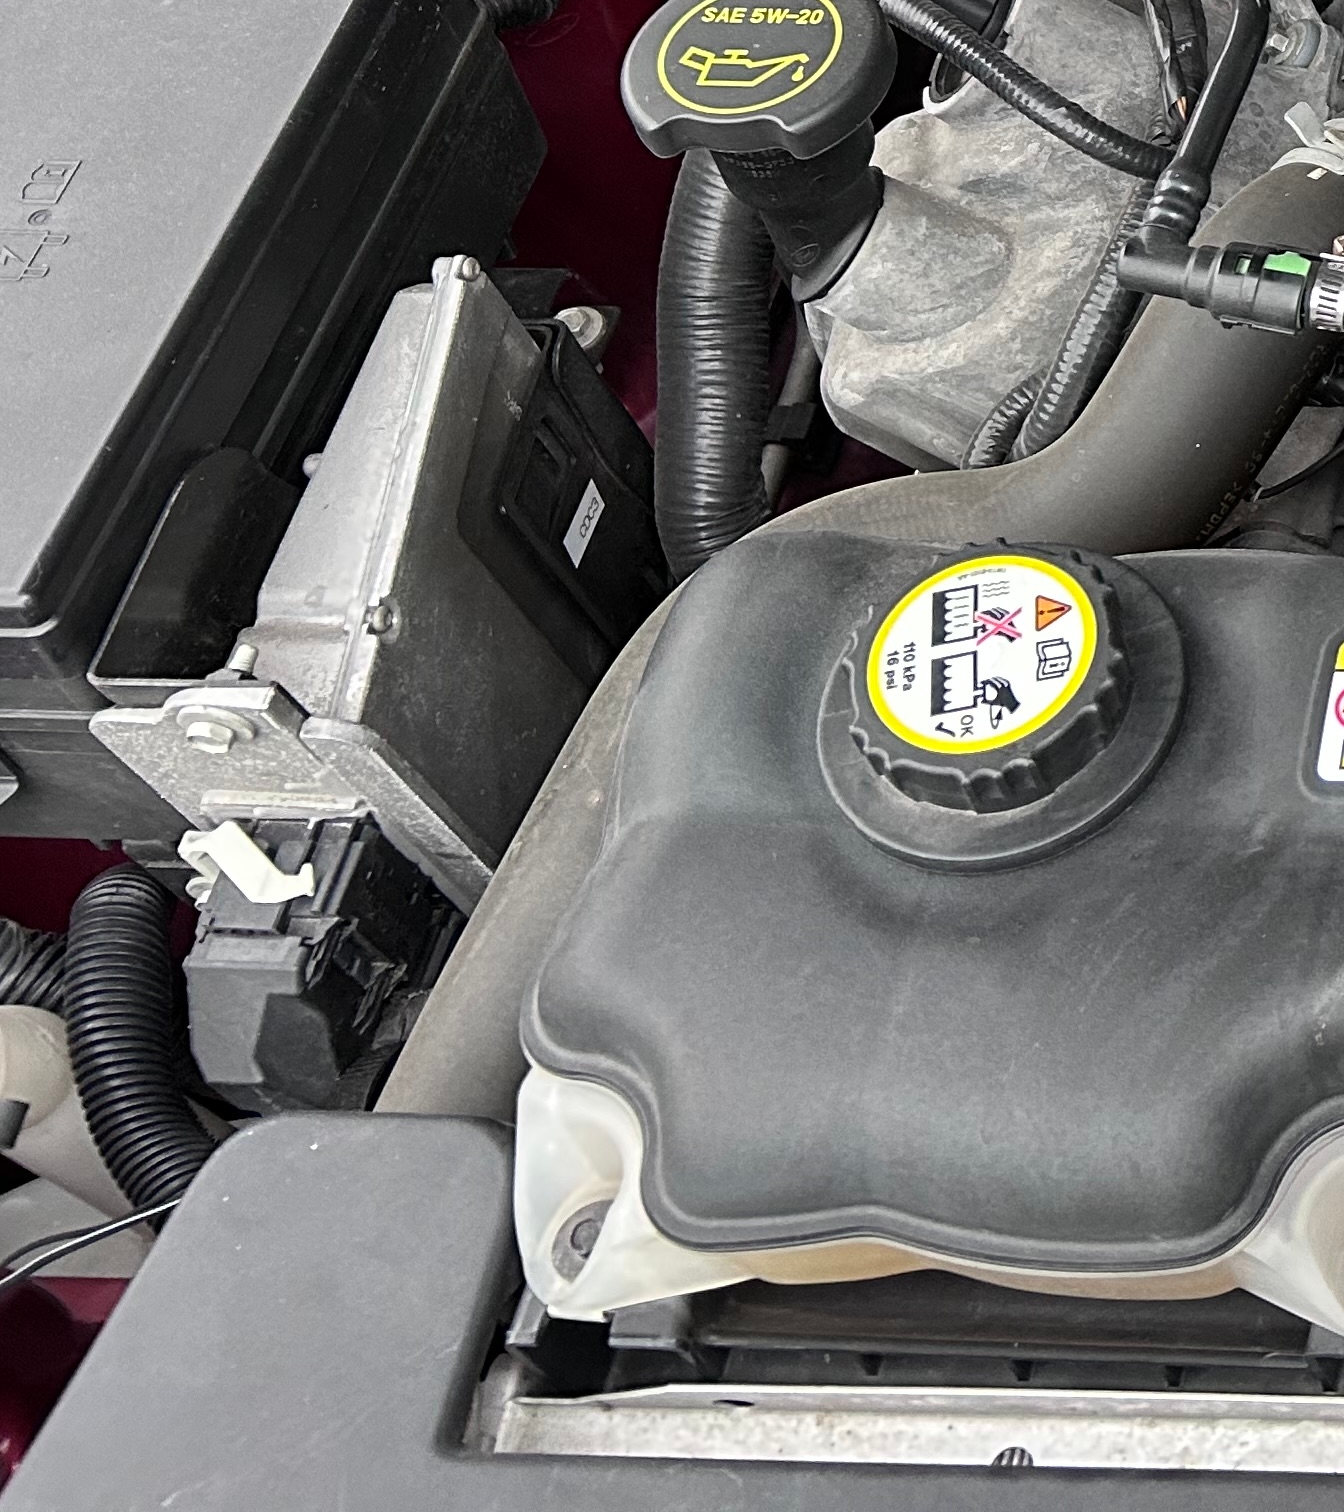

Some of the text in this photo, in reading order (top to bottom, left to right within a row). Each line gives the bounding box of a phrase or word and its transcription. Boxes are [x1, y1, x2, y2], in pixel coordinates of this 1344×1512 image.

[701, 6, 825, 25] SAE 5W-20
[884, 648, 899, 691] 16 psi
[902, 641, 917, 692] 110 kPa
[959, 714, 975, 739] OK
